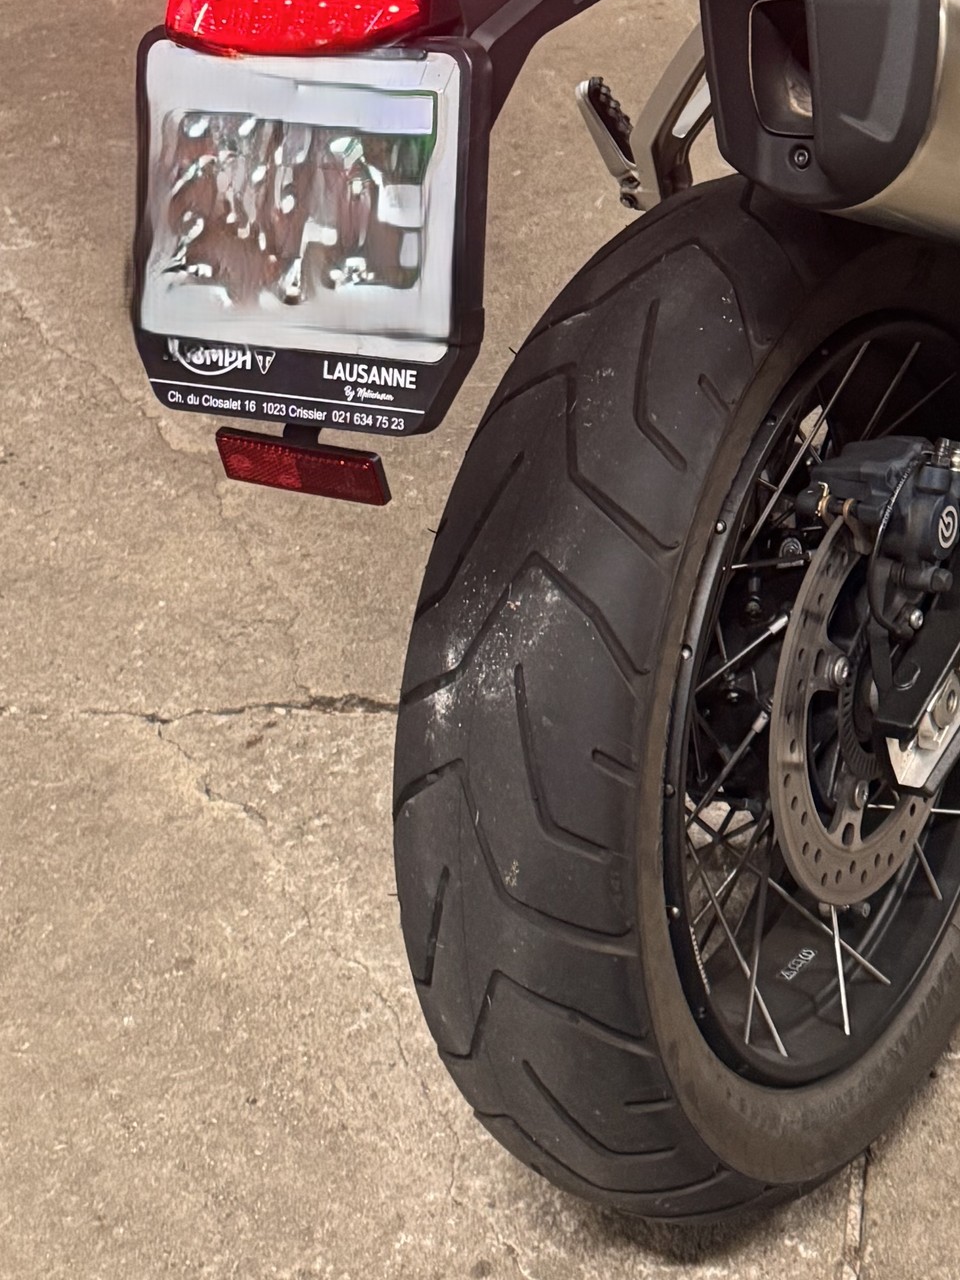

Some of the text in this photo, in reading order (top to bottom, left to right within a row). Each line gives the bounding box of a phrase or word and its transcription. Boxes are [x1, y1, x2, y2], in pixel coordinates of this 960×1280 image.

[323, 360, 417, 389] LAUSANNE
[167, 390, 405, 430] Ch. du Closalet 16 1023 Crissier 021 634 75 23
